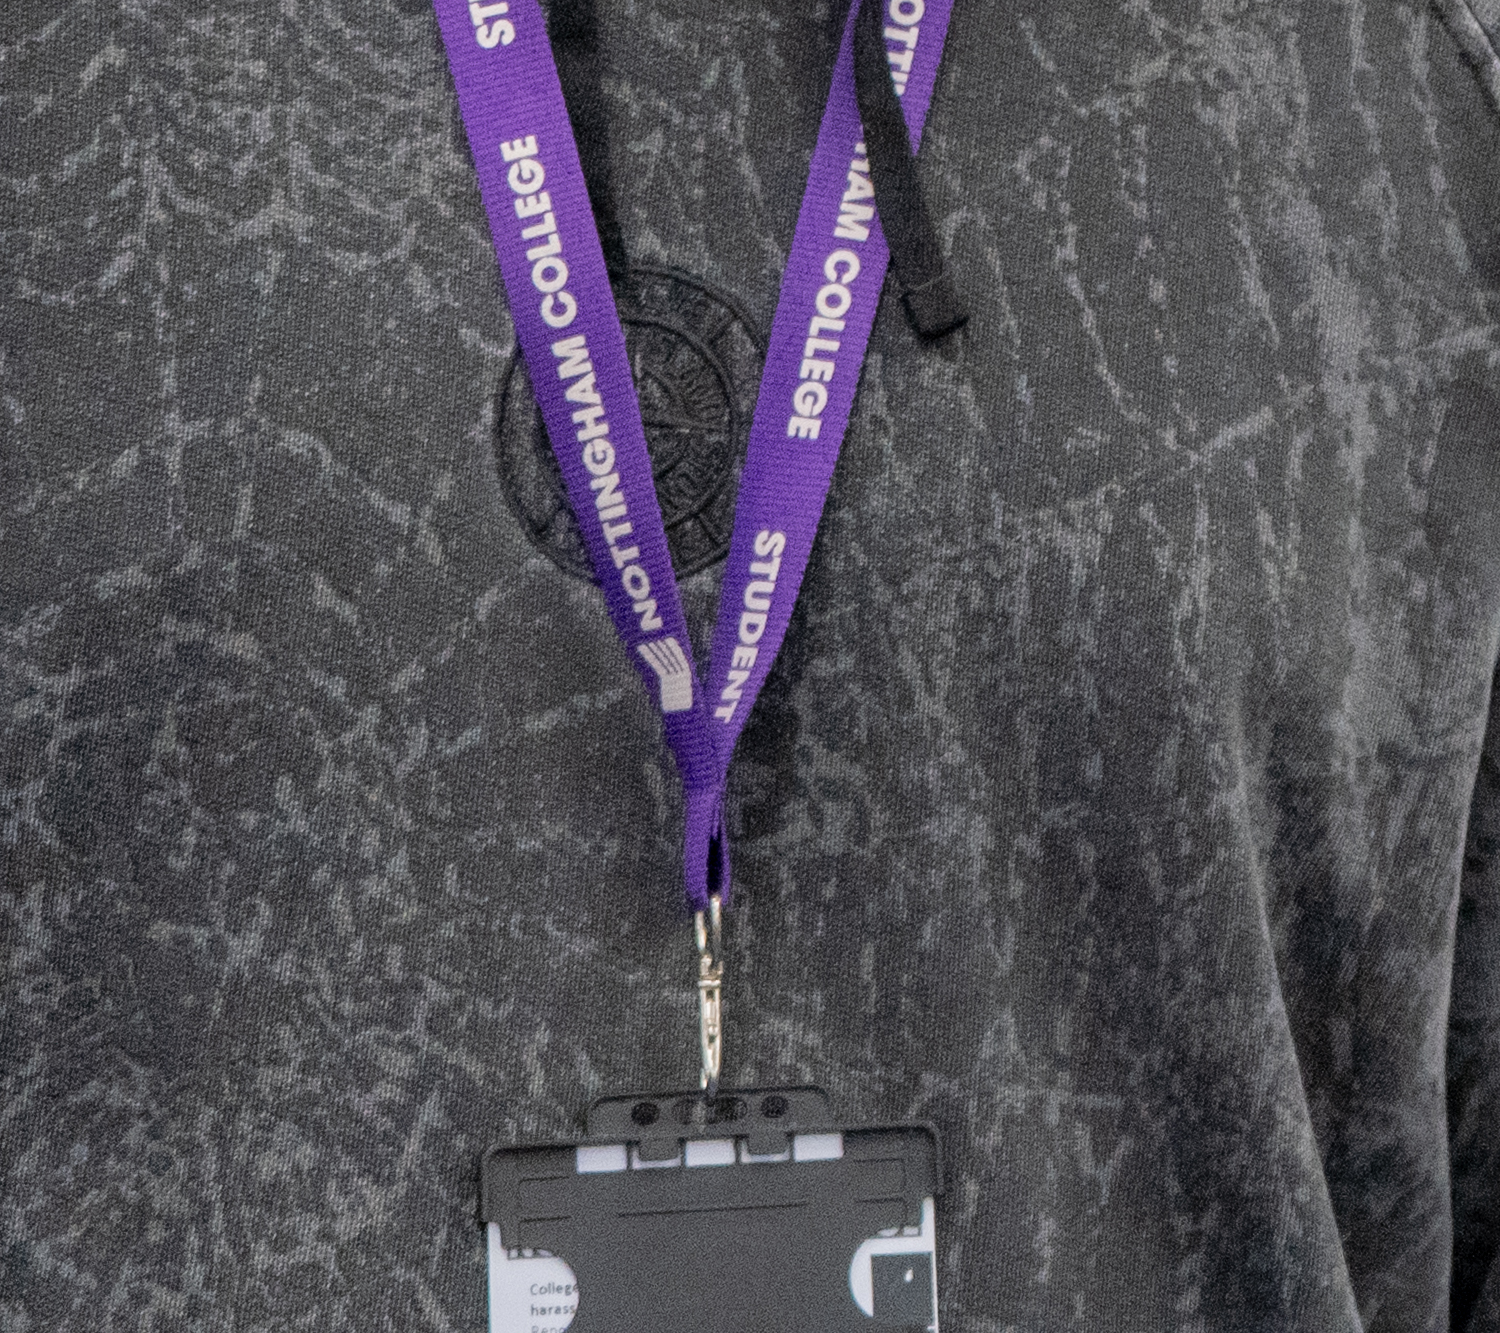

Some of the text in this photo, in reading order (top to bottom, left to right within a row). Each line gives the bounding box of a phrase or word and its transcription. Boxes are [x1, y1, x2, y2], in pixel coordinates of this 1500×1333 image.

[500, 134, 663, 631] NOTTINGHAM COLLEGE
[787, 249, 861, 440] COLLEGE
[714, 530, 786, 723] STUDENT
